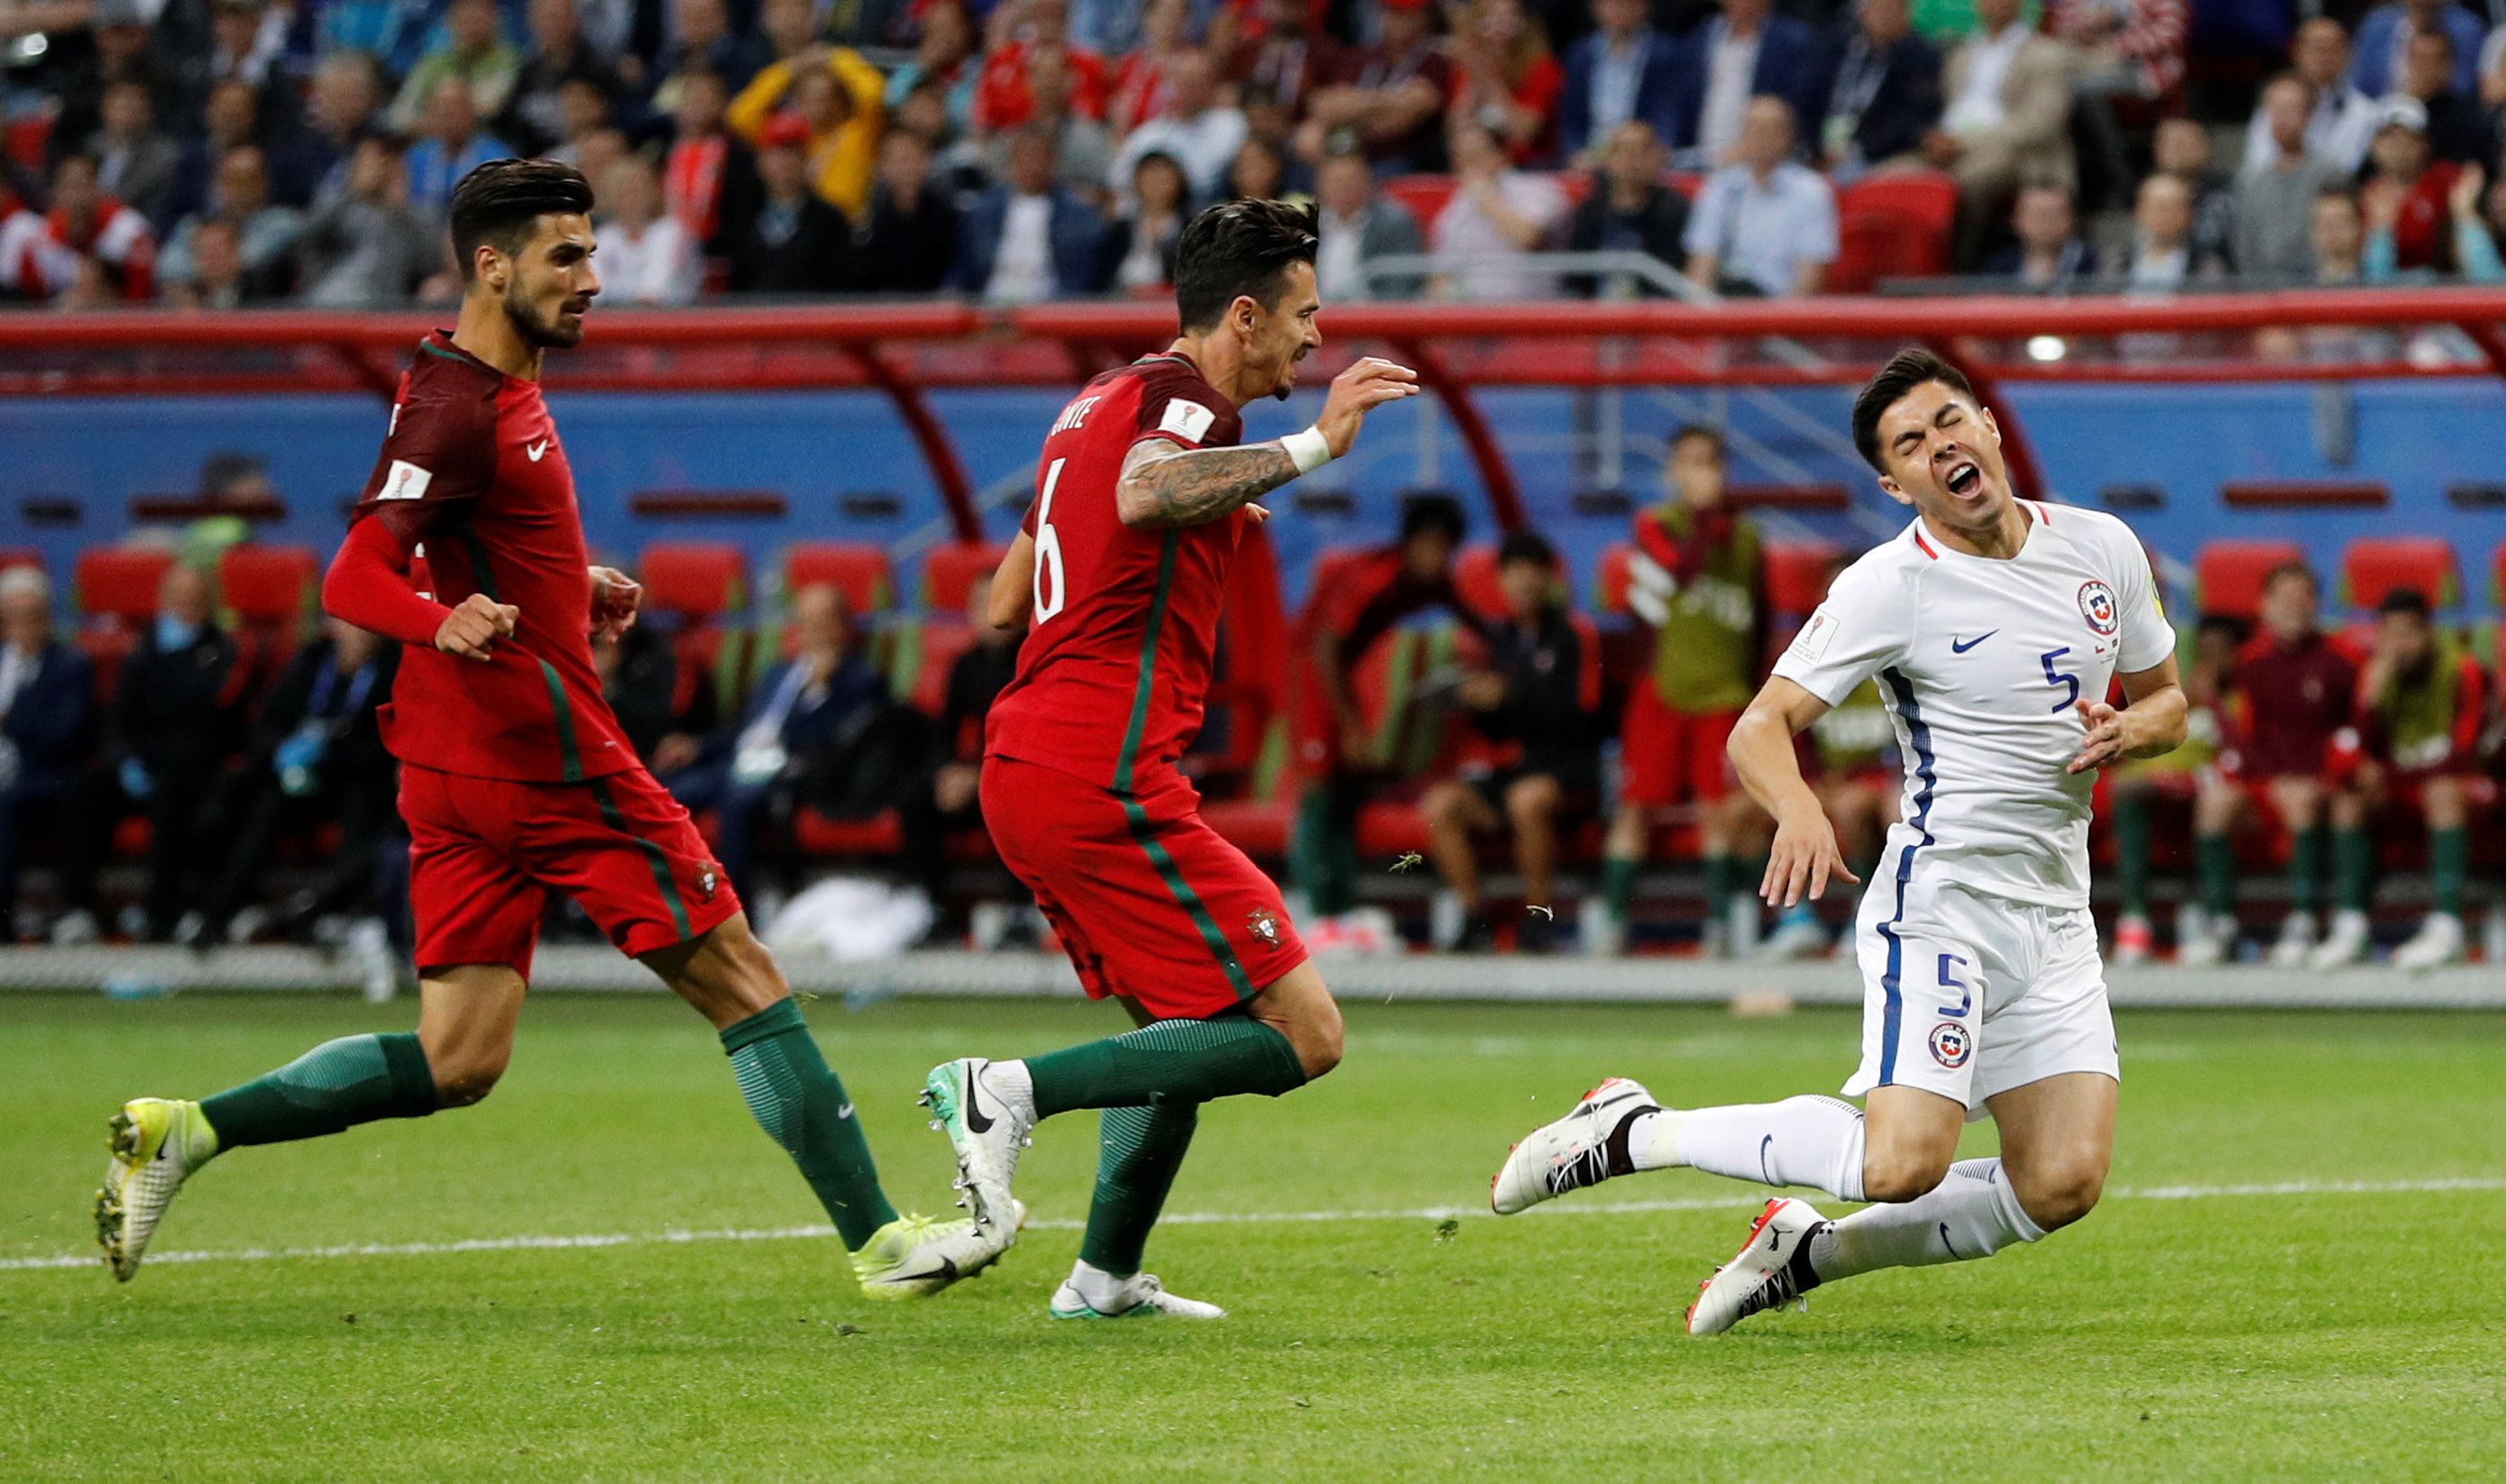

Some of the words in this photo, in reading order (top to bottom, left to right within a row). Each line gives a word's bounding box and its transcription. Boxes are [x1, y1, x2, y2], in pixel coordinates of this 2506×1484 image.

[1033, 457, 1066, 626] 6
[2041, 646, 2079, 714] 5
[1938, 954, 1971, 1017] 5
